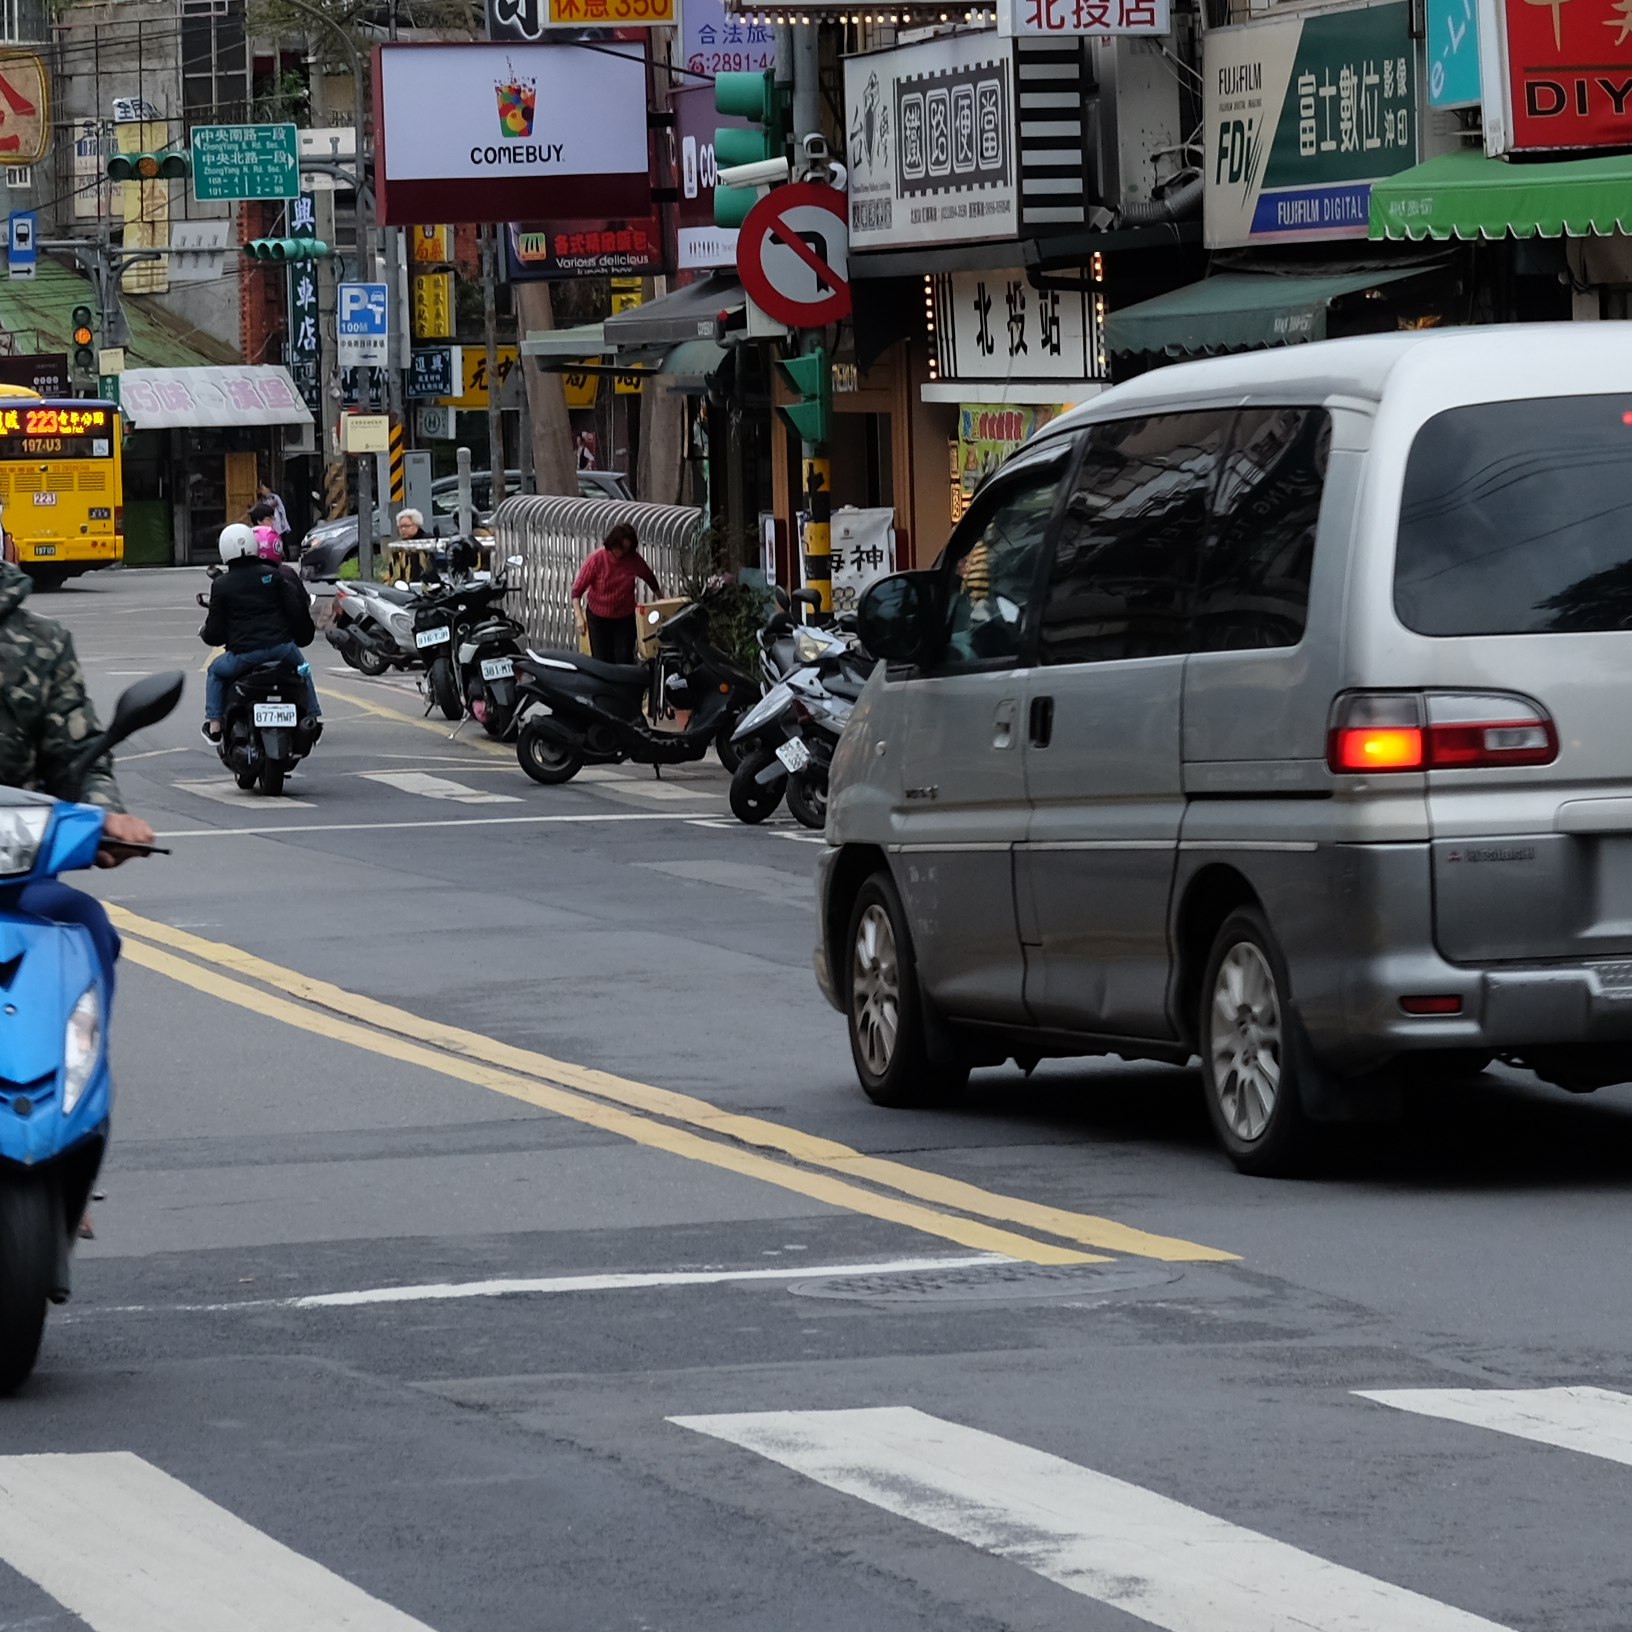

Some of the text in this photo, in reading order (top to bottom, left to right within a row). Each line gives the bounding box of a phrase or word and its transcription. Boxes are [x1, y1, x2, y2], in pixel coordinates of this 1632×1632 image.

[698, 23, 775, 45] 合法旅
[1218, 62, 1262, 96] FUJIFILM
[1297, 60, 1381, 157] 富士數位
[200, 127, 287, 142] 中央南路一段
[904, 91, 999, 166] 鐵路便當
[201, 150, 288, 165] 中央北路一段
[470, 144, 564, 165] COMEBUY
[1277, 198, 1319, 225] FUJIFILM
[1323, 195, 1363, 221] DIGITAL
[556, 254, 649, 268] Various delicious
[342, 287, 368, 321] P
[974, 279, 1060, 358] 北投站
[122, 377, 296, 413] 巧味 漢堡
[26, 410, 58, 434] 223
[35, 494, 56, 504] 223
